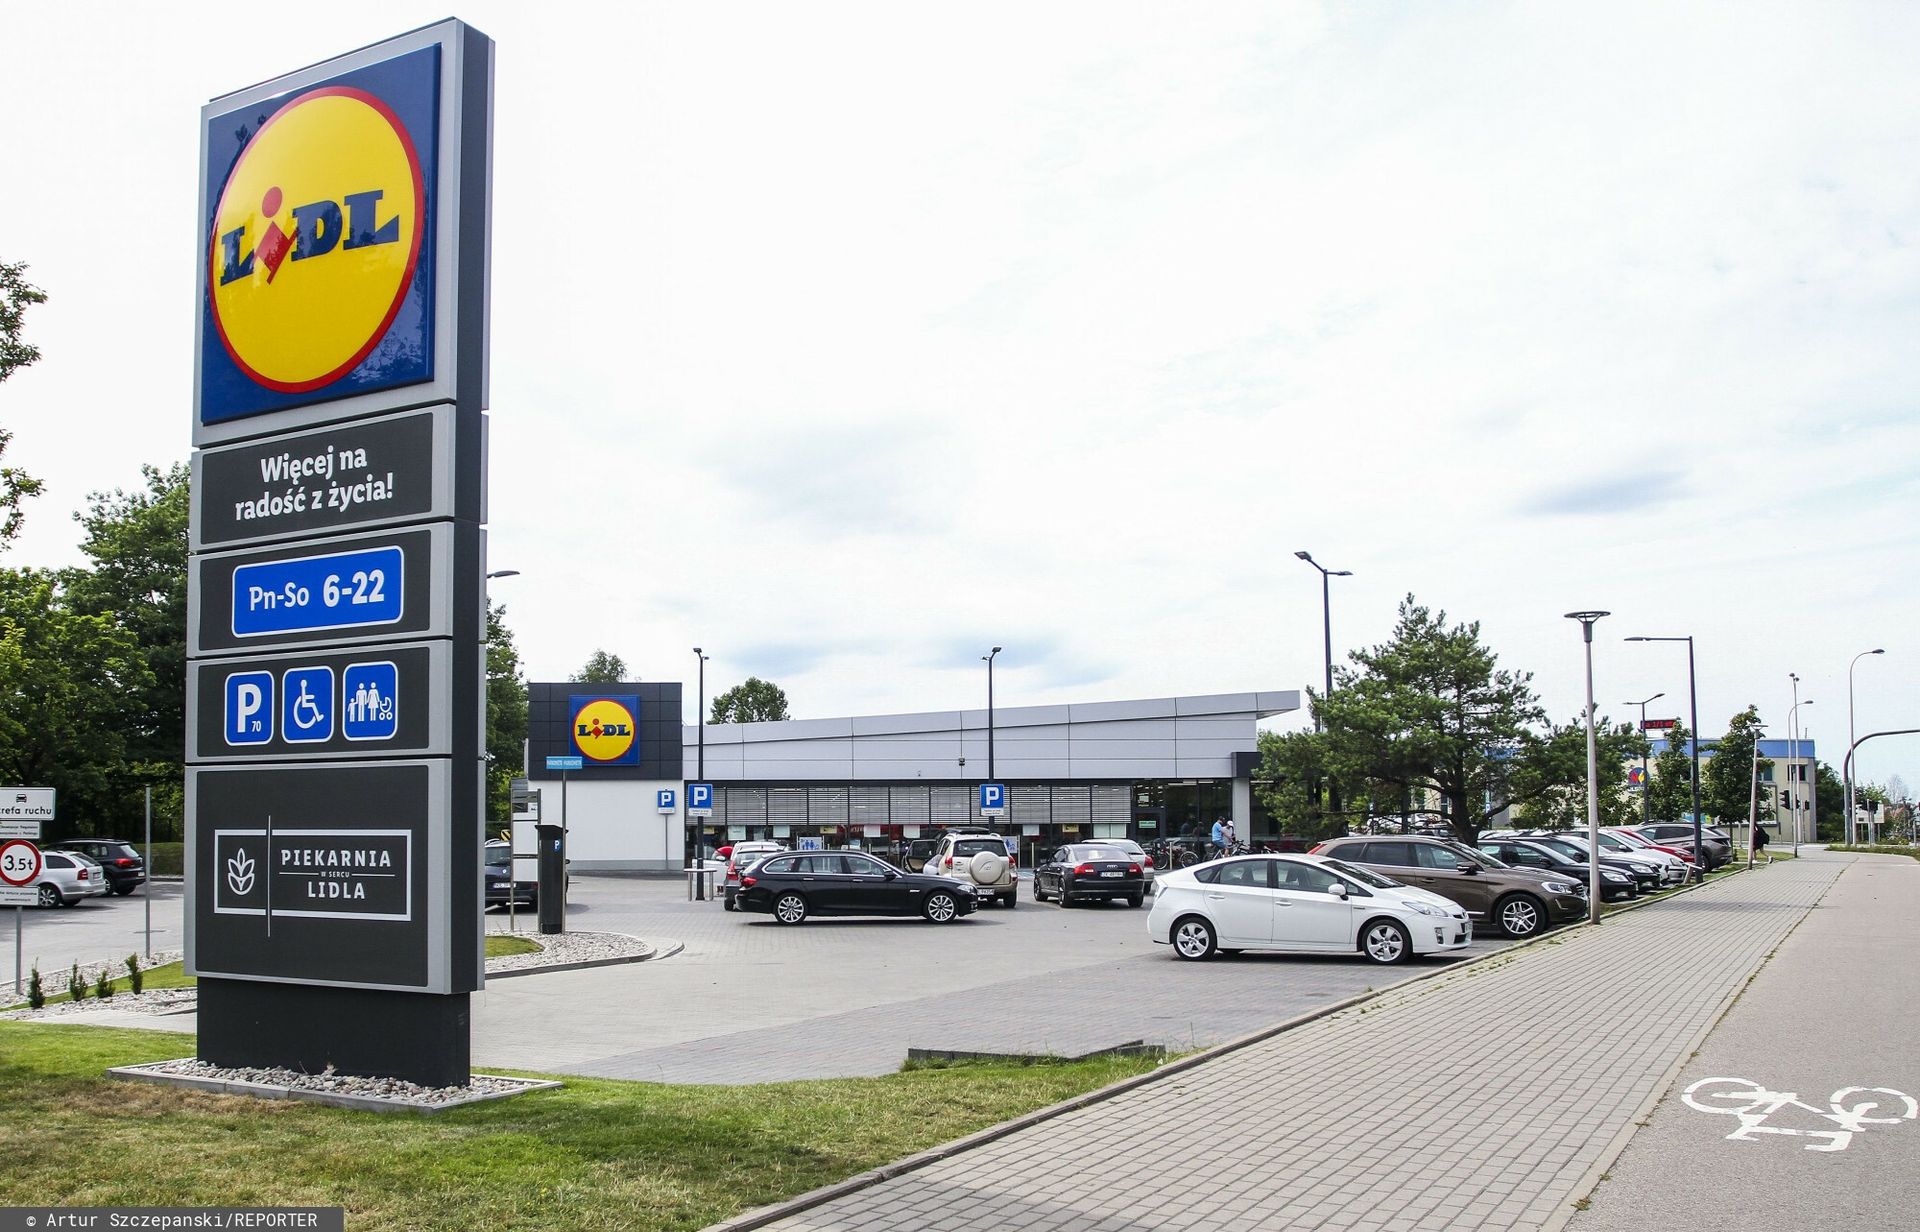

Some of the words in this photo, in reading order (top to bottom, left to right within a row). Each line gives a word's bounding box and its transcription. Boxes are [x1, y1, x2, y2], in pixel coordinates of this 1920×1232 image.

[260, 445, 334, 485] Więcej
[340, 448, 367, 471] na
[235, 486, 306, 521] radość
[311, 489, 322, 510] z
[328, 472, 394, 512] życia!
[249, 582, 310, 611] Pn-So
[323, 568, 385, 608] 6-22
[237, 683, 262, 733] P
[251, 720, 261, 733] 70
[661, 791, 672, 806] P
[694, 786, 708, 806] P
[986, 786, 999, 806] P
[0, 806, 21, 815] refa
[25, 806, 52, 815] ruchu
[281, 849, 391, 867] PIEKARNIA
[308, 881, 365, 899] LIDLA
